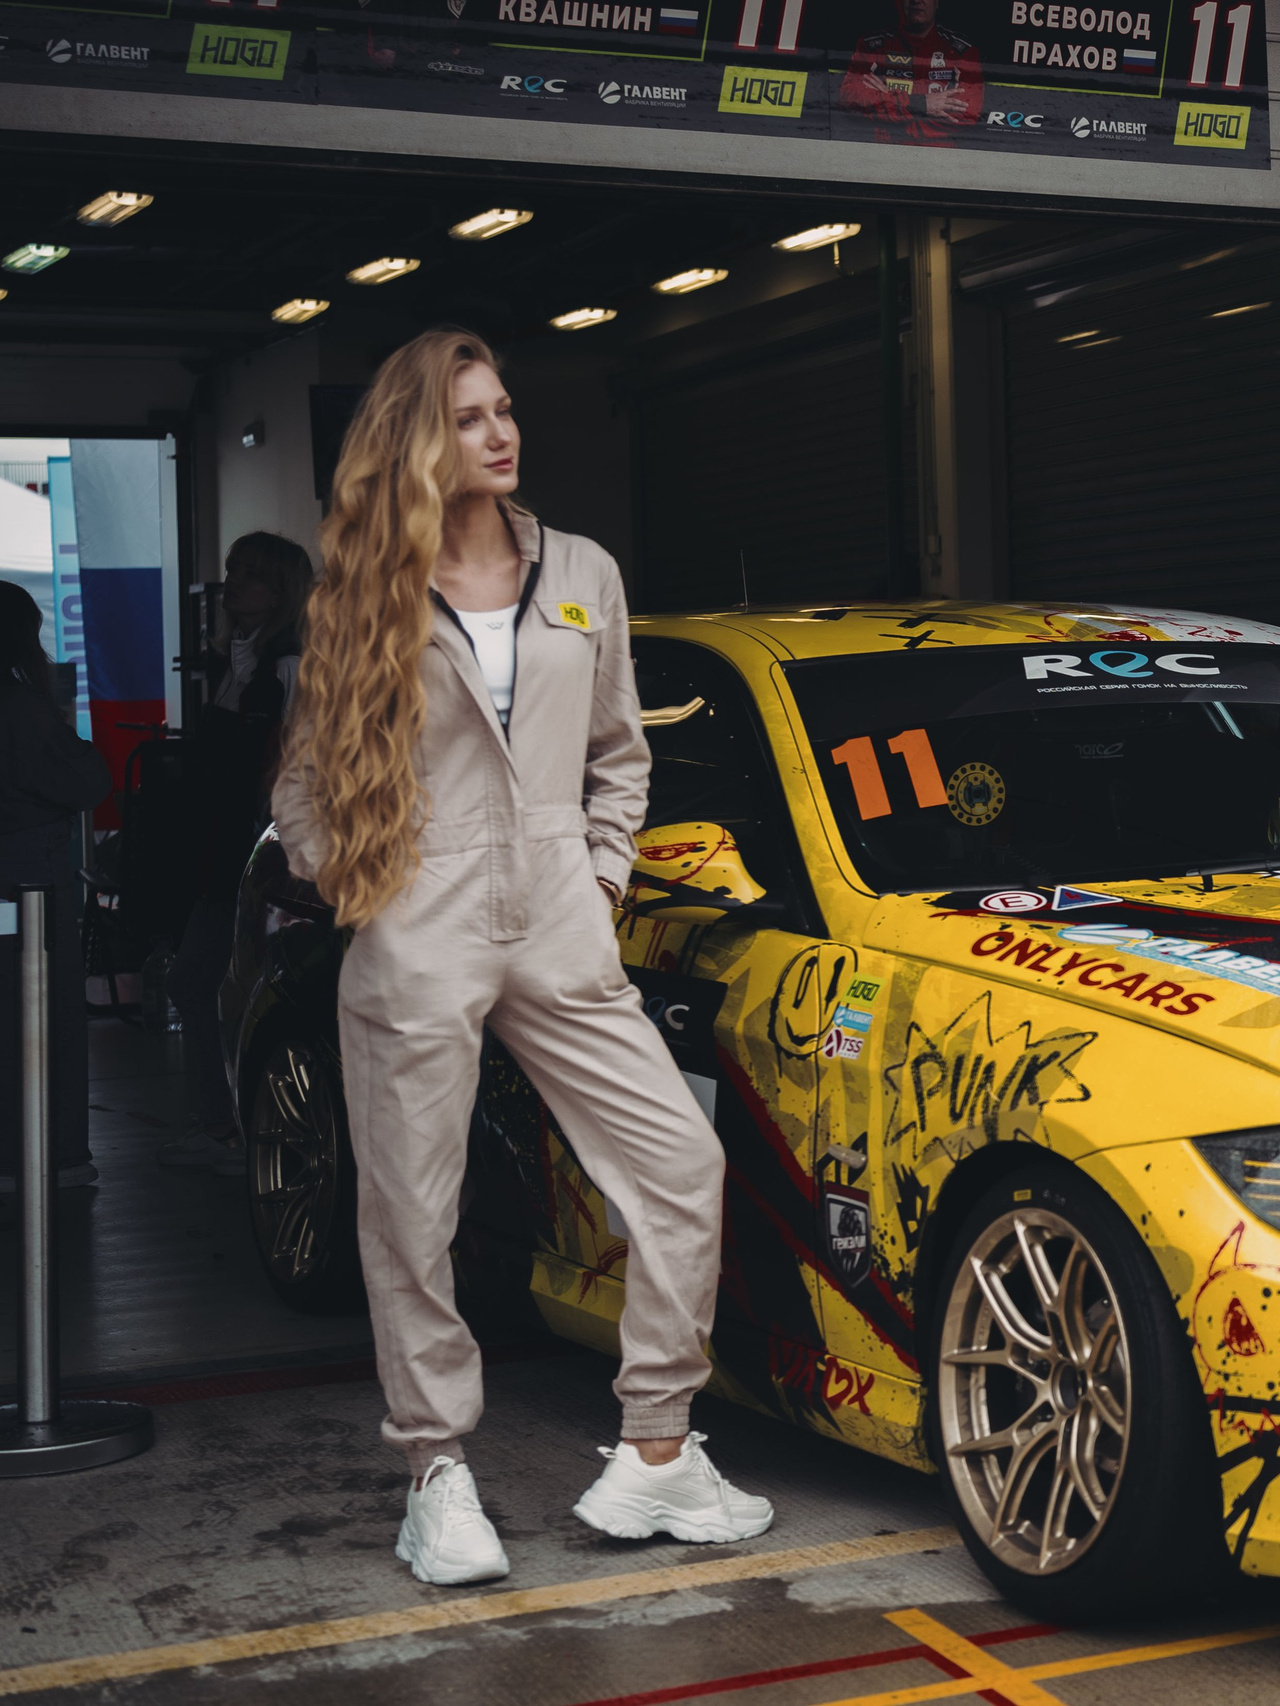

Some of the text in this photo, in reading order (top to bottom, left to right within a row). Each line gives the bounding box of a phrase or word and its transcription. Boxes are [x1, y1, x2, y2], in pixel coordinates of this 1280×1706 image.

[499, 0, 652, 32] КВАШНИН
[1012, 2, 1151, 40] ВСЕВОЛОД
[76, 42, 150, 61] ГАЛВЕНТ
[201, 35, 278, 68] HOGO
[1013, 40, 1118, 71] ПРАХОВ
[1190, 1, 1252, 87] 11
[624, 84, 687, 101] ГАЛВЕНТ
[729, 76, 796, 107] HOGO
[1092, 119, 1148, 135] ГАЛВЕНТ
[1184, 112, 1242, 139] HOGO
[1036, 685, 1097, 694] РОССИЙСКАЯ
[1179, 682, 1249, 690] ВЫНОСЛИВОСТЬ
[831, 728, 949, 821] 11
[971, 931, 1217, 1016] ONLYCARS
[842, 1038, 863, 1053] TSS
[911, 1051, 1060, 1142] PUNK
